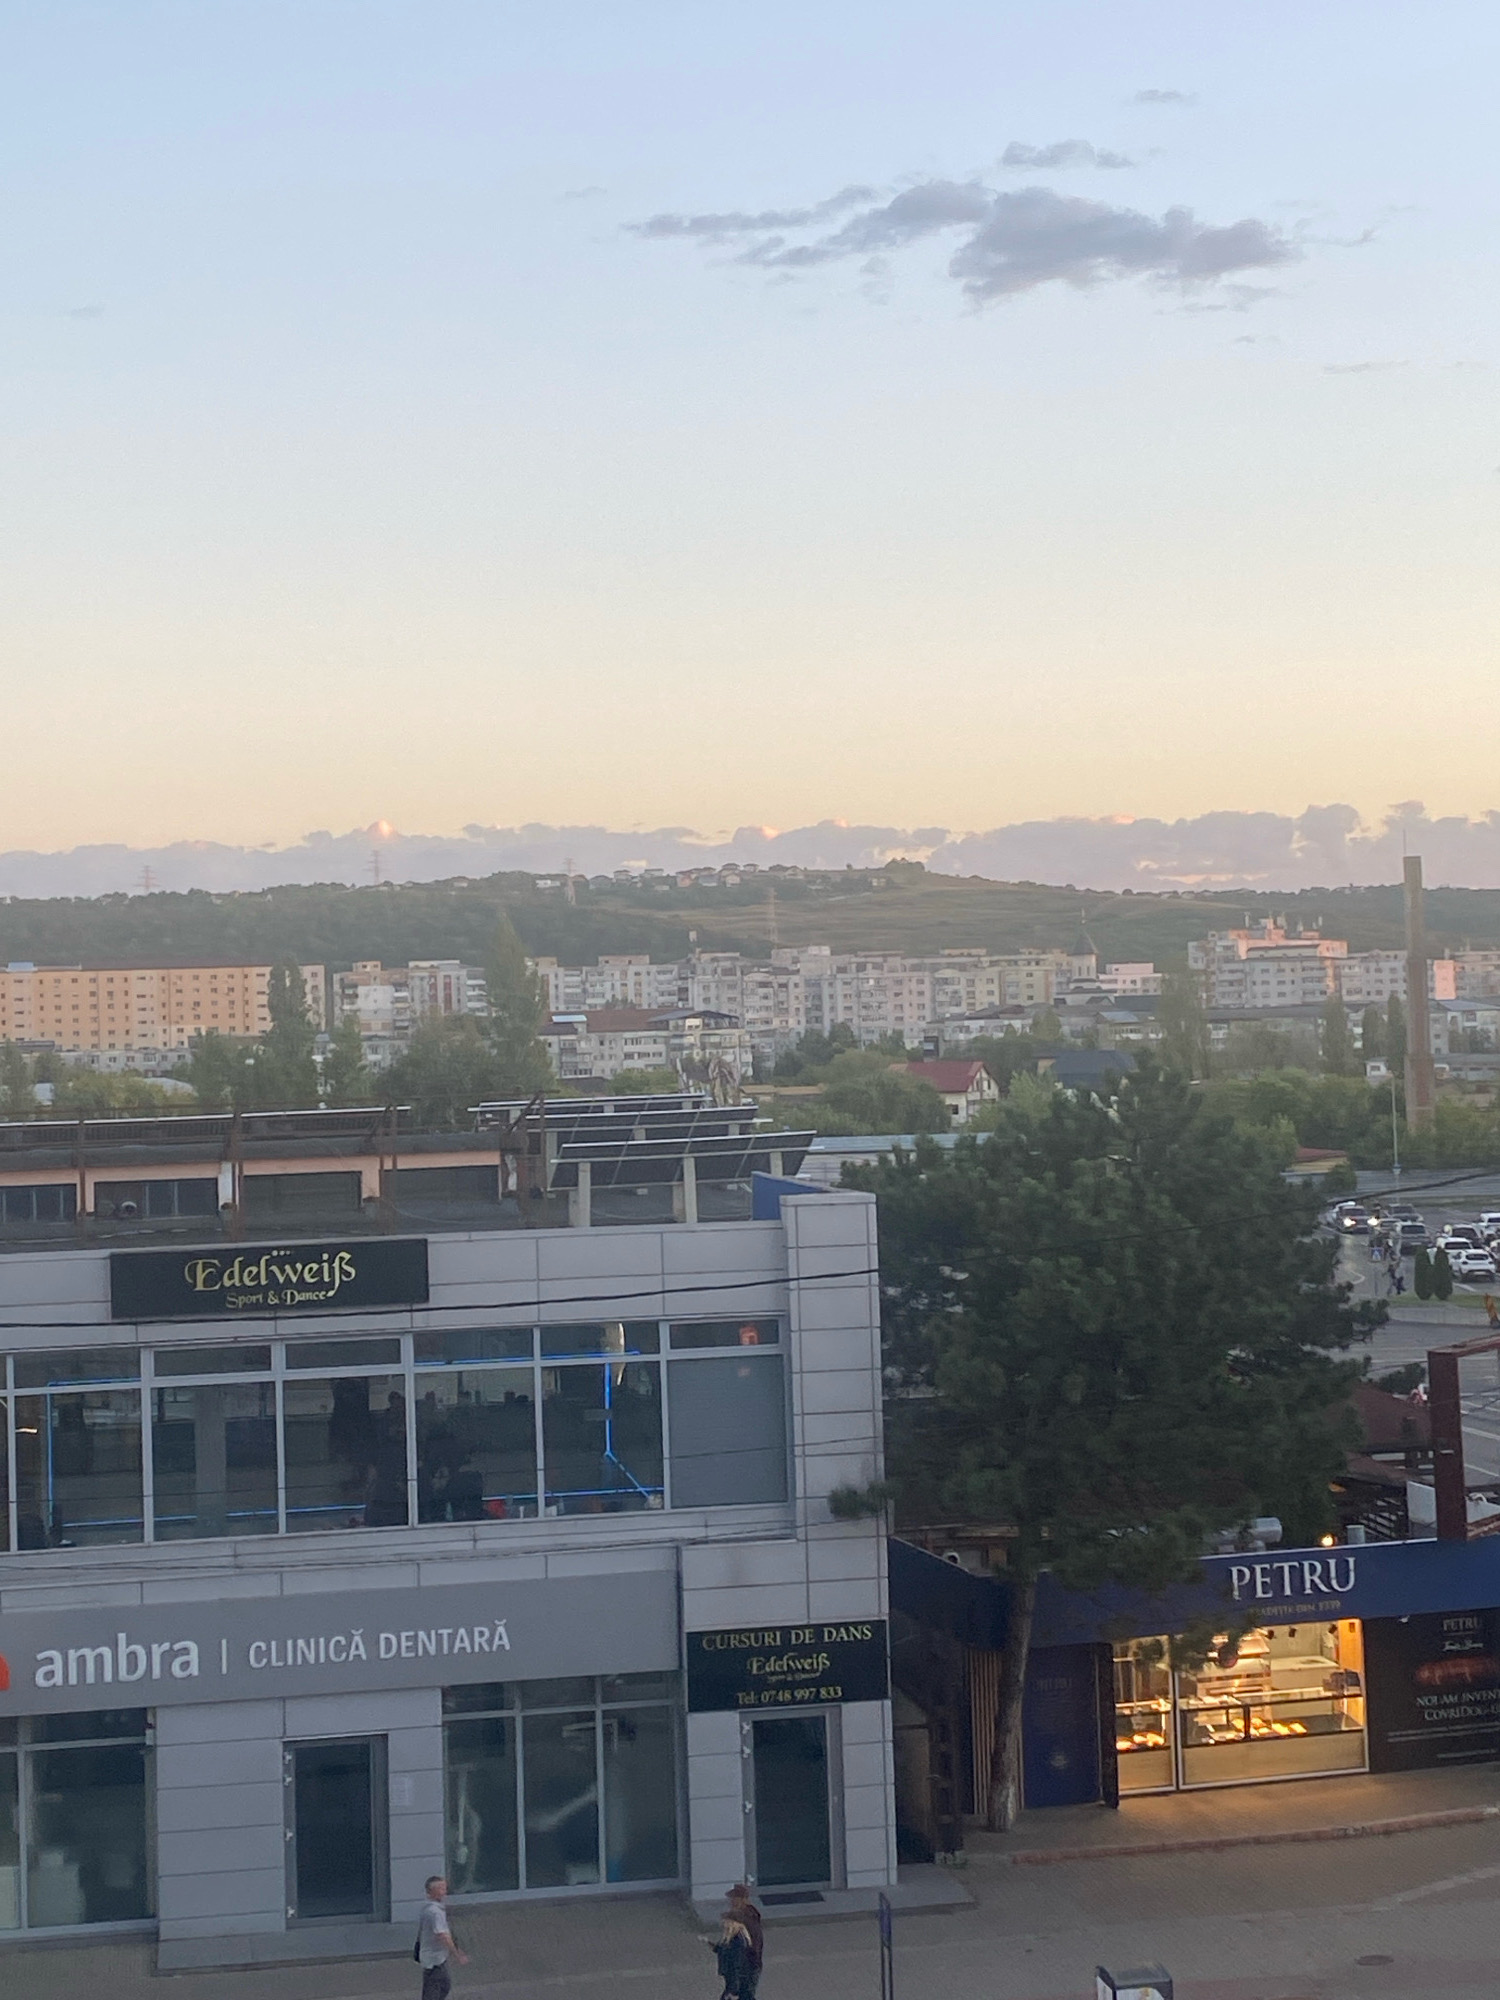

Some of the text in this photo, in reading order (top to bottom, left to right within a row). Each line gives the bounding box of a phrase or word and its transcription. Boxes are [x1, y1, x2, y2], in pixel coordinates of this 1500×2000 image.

[226, 1288, 327, 1309] Sport & Dance
[1229, 1556, 1356, 1600] PETRU
[35, 1619, 511, 1688] ambra CLINICĂ DENTARĂ
[702, 1625, 872, 1650] CURSURI DE DANS
